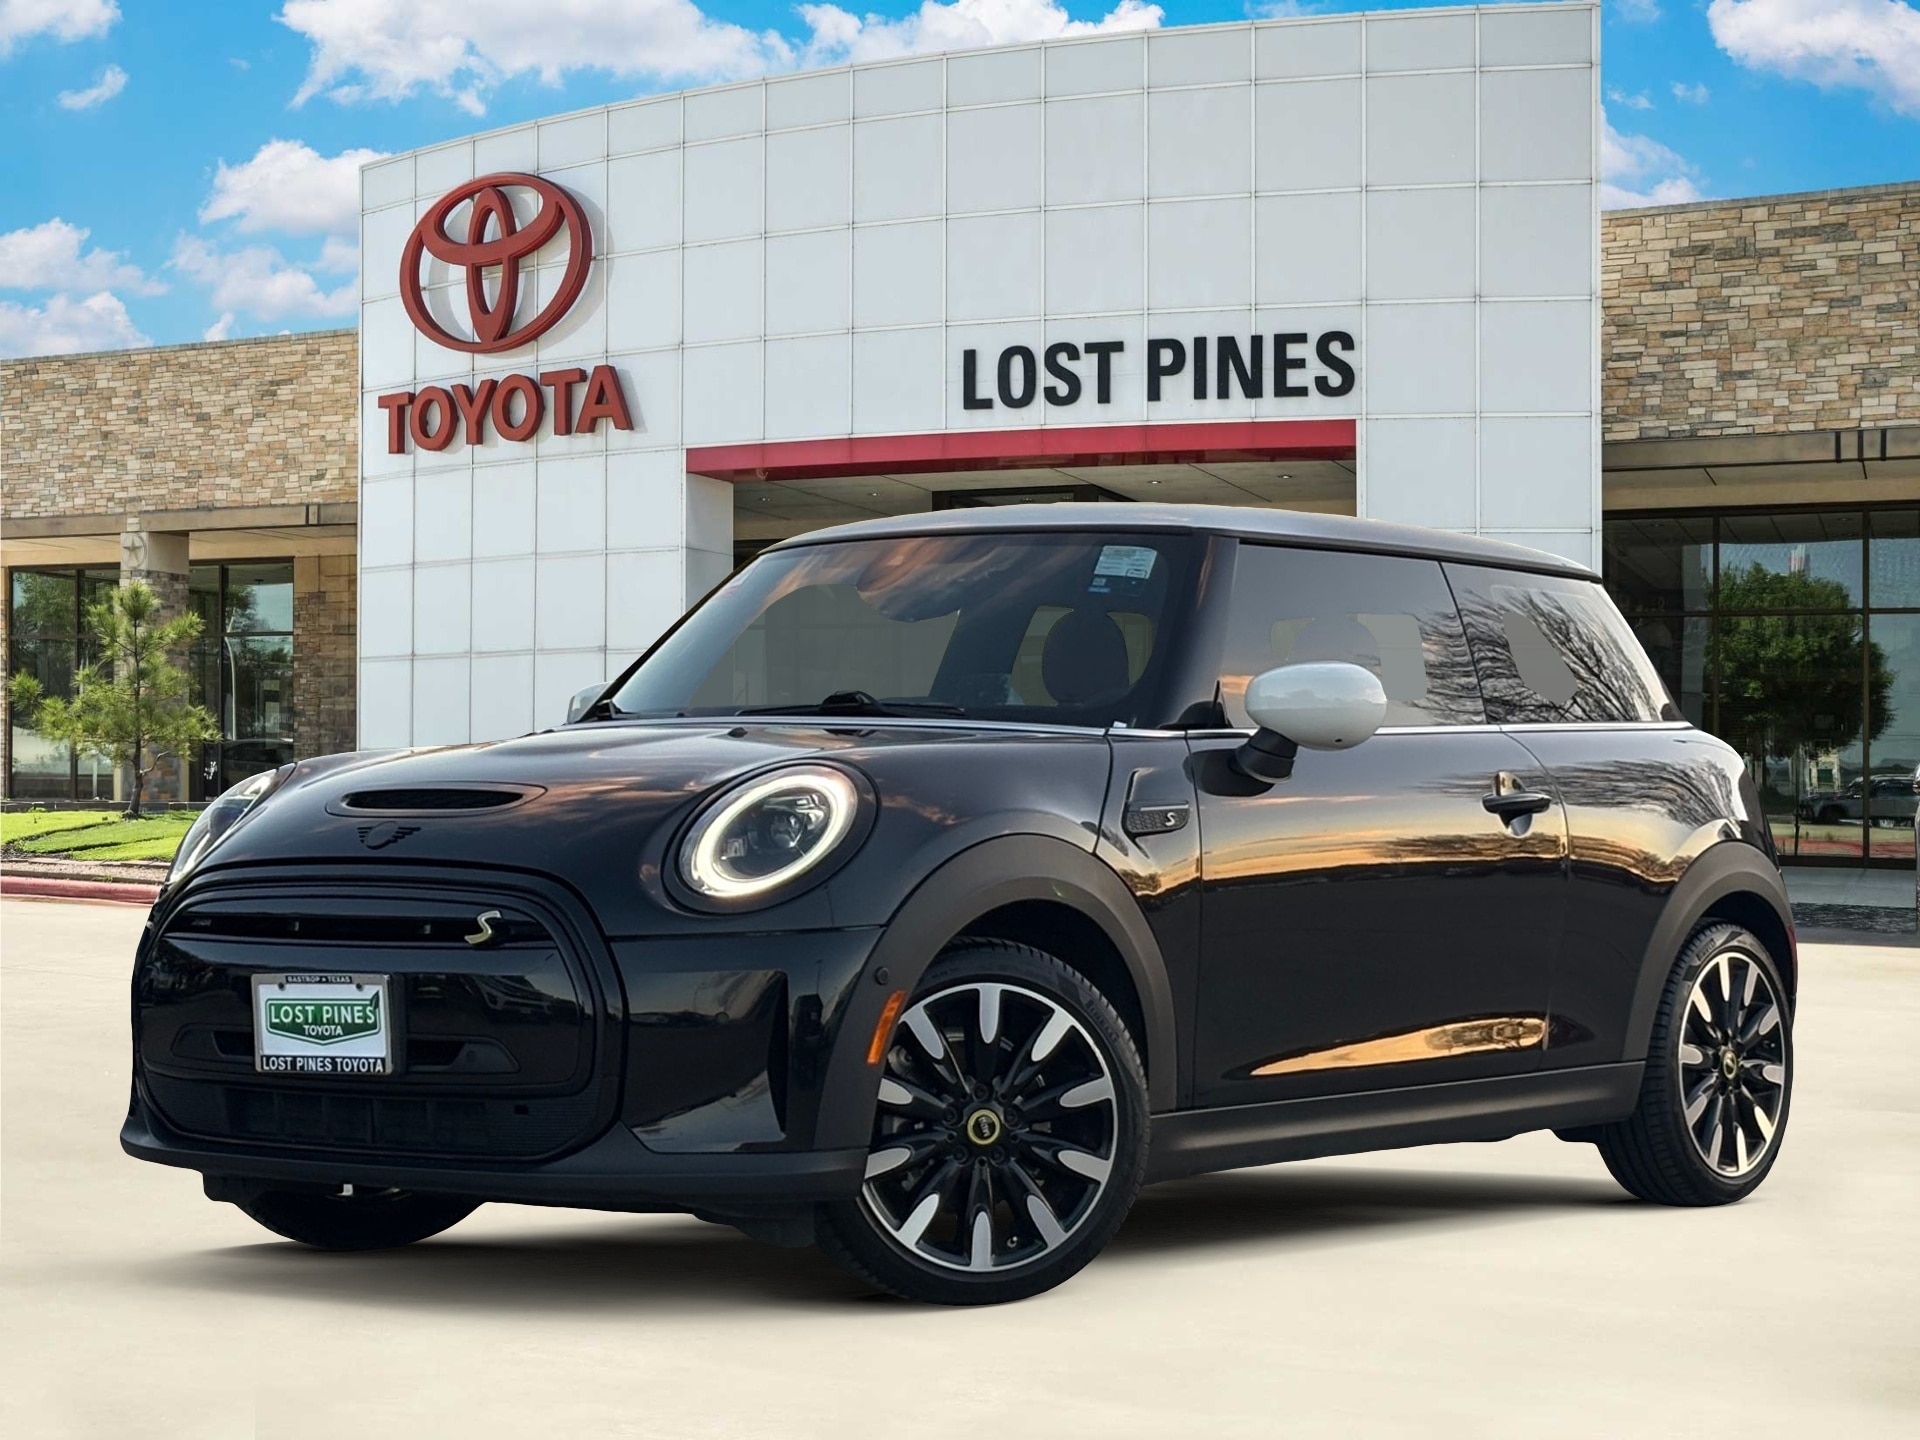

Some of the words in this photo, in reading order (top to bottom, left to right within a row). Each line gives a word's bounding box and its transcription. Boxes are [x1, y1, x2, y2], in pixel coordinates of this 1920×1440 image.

[963, 341, 1124, 410] LOST
[1147, 331, 1356, 402] PINES
[378, 364, 635, 454] TOYOTA
[1164, 811, 1176, 827] S
[464, 910, 501, 944] S
[287, 975, 321, 983] BASTROP
[327, 975, 351, 983] TEXAS
[270, 1005, 315, 1024] LOST
[322, 1005, 375, 1024] PINES
[303, 1025, 344, 1036] TOYOTA
[262, 1056, 293, 1071] LOST
[296, 1057, 332, 1072] PINES
[335, 1058, 384, 1073] TOYOTA
